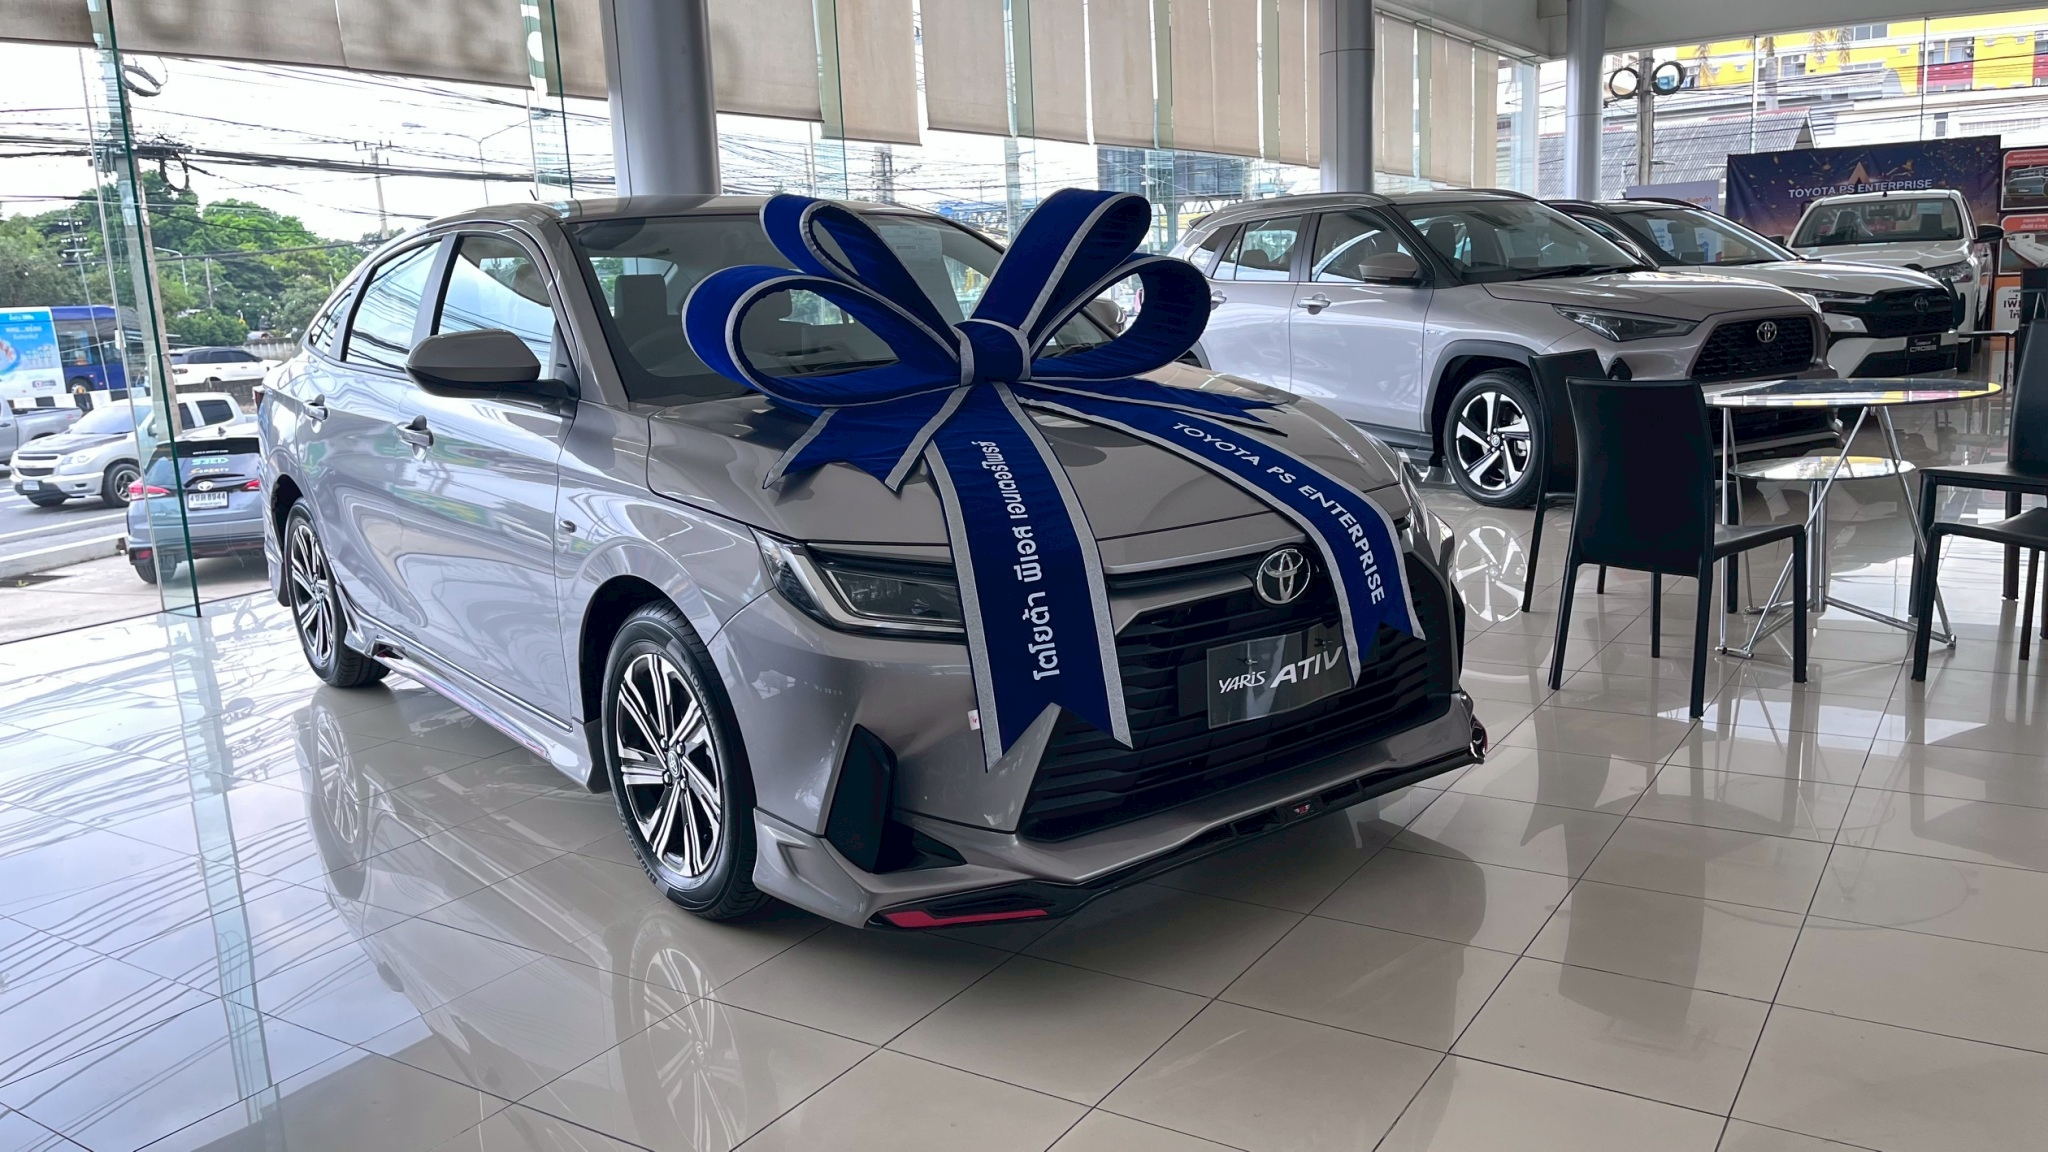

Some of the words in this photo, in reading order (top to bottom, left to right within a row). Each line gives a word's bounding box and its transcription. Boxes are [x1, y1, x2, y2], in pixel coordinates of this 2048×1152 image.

[1788, 186, 1836, 199] TOYOTA
[1839, 184, 1855, 194] PS
[1857, 179, 1933, 193] ENTERPRISE
[1172, 422, 1260, 466] TOYOTA
[1266, 466, 1297, 484] PS
[1298, 485, 1385, 605] ENTERPRISE
[1012, 525, 1042, 583] พีเอส
[1022, 591, 1060, 681] โตโยต้า
[1269, 646, 1343, 689] ATIV
